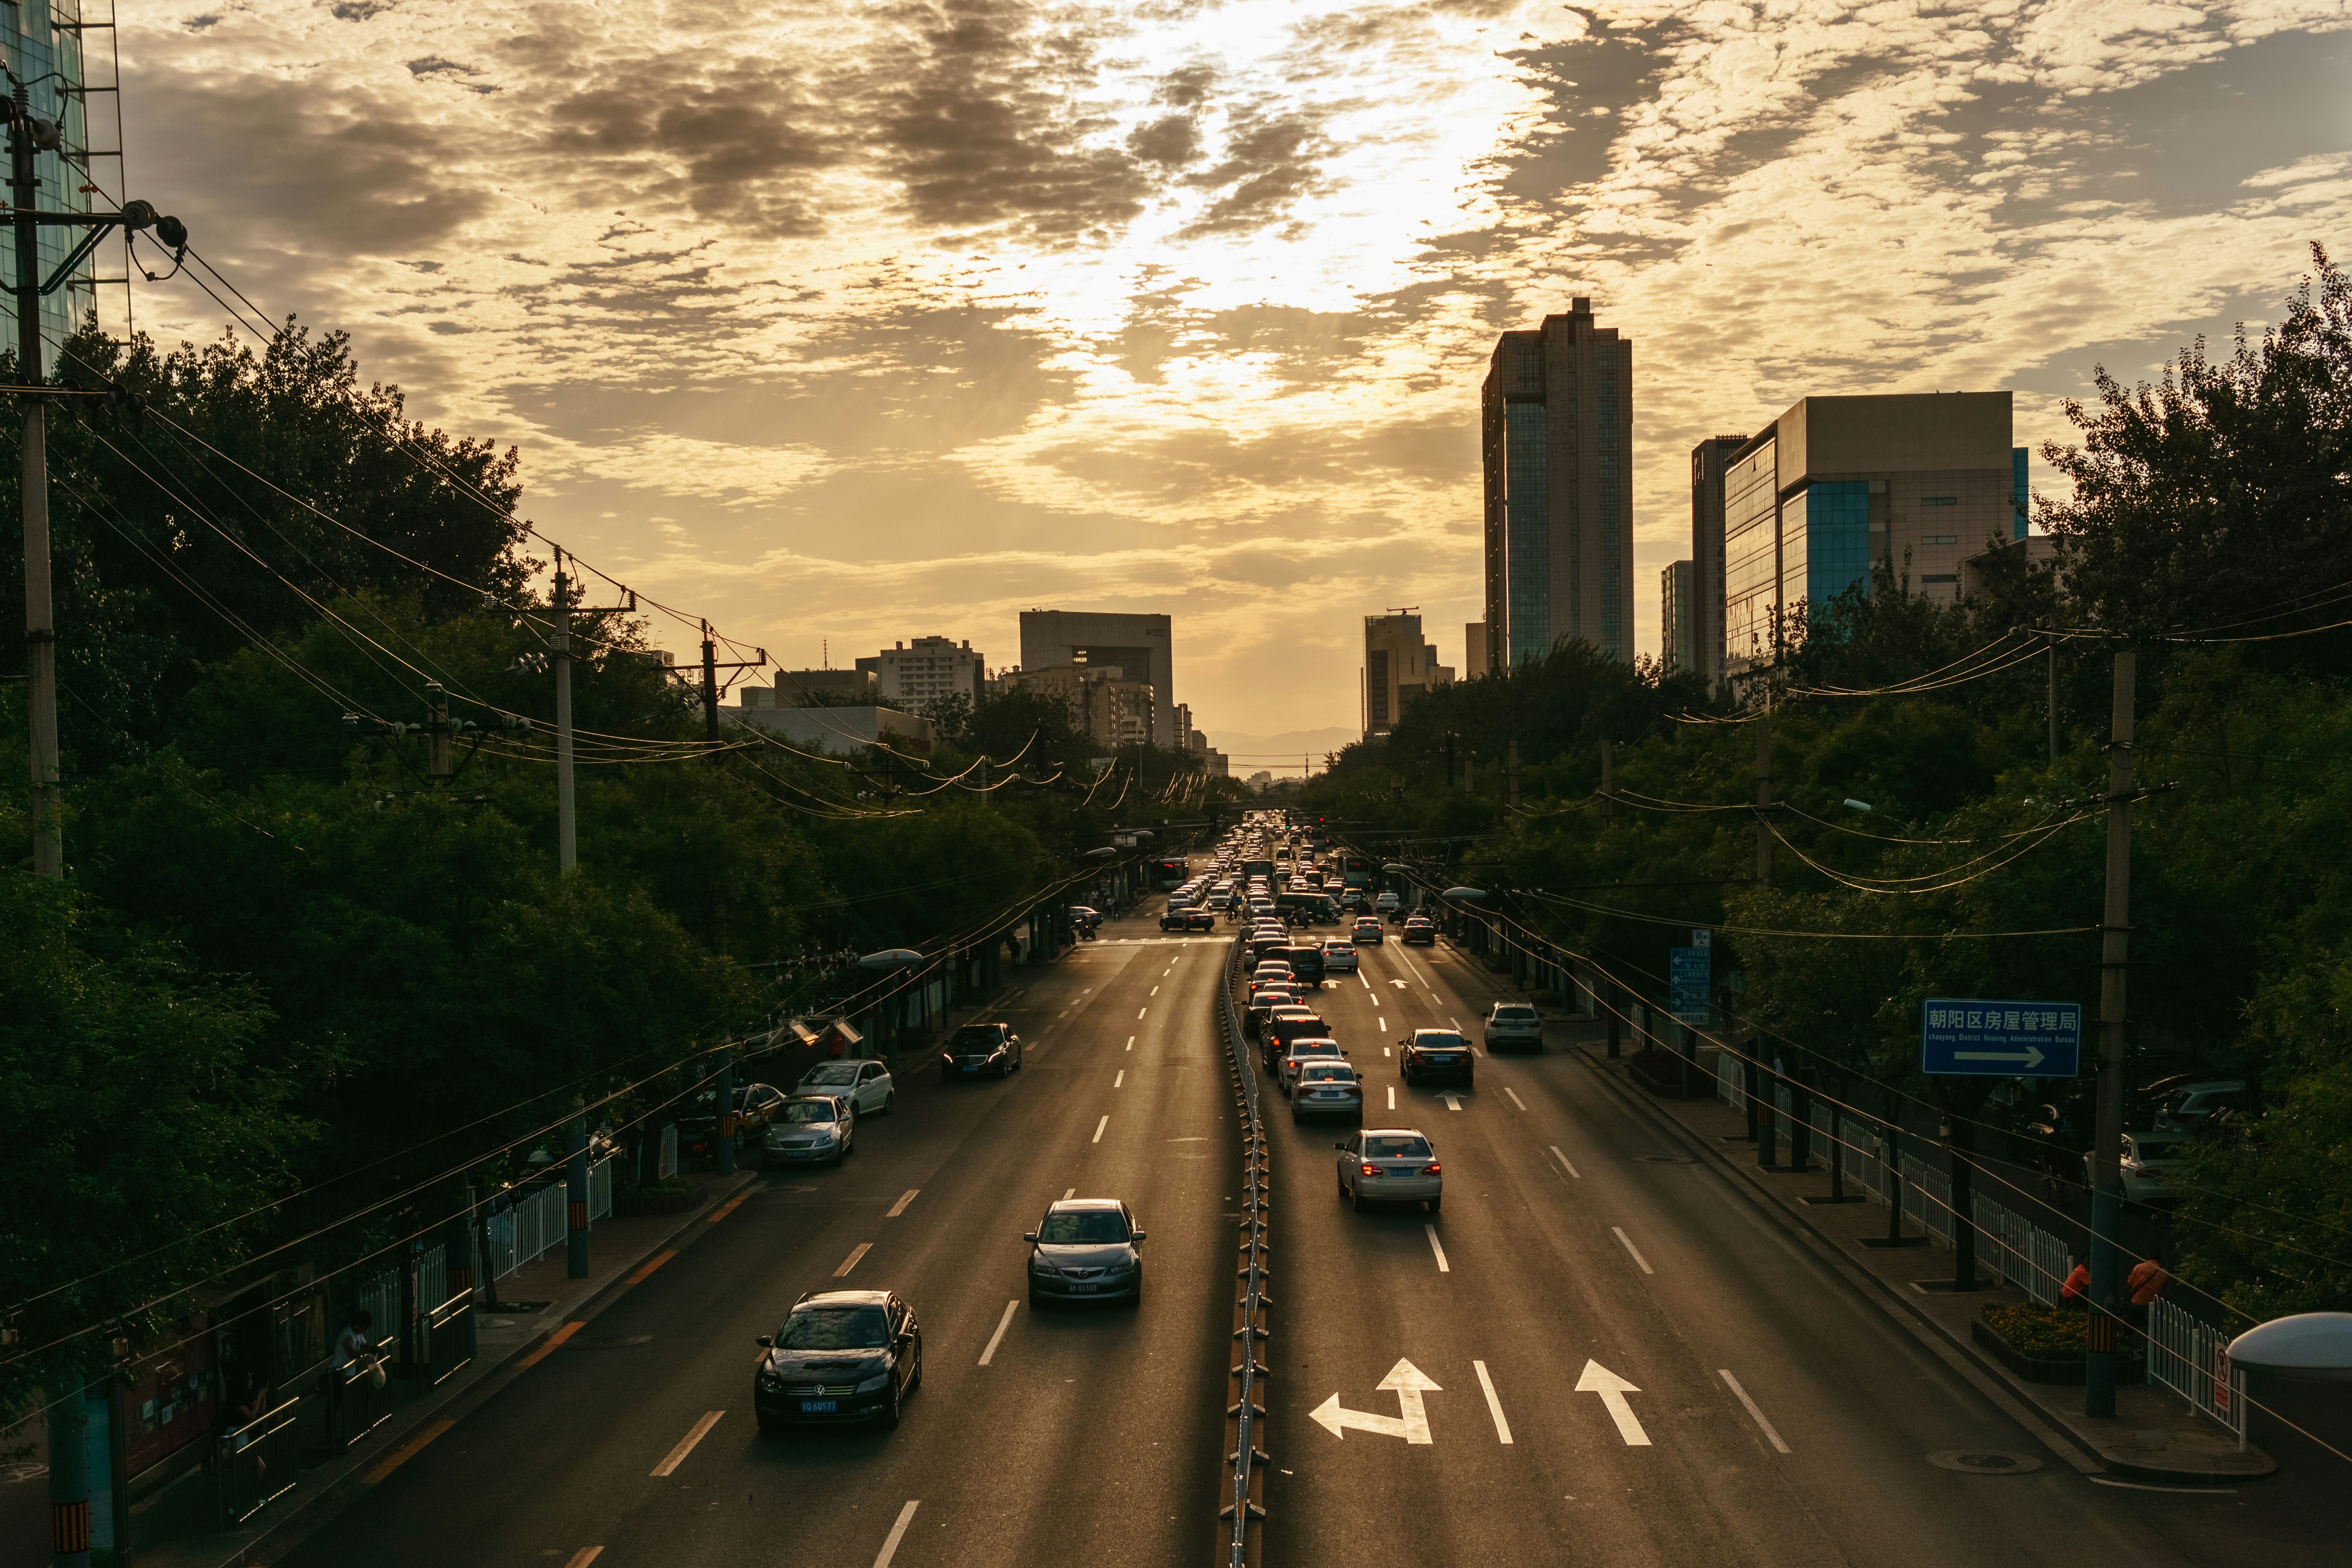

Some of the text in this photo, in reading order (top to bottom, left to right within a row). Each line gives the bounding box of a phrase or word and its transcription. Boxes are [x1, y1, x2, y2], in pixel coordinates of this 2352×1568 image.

[1929, 1009, 2076, 1031] 朝阳区房屋管理局
[1928, 1033, 1955, 1042] chaoyang
[1959, 1033, 1980, 1041] District
[1984, 1034, 2007, 1043] Housing
[2010, 1035, 2052, 1043] Administration
